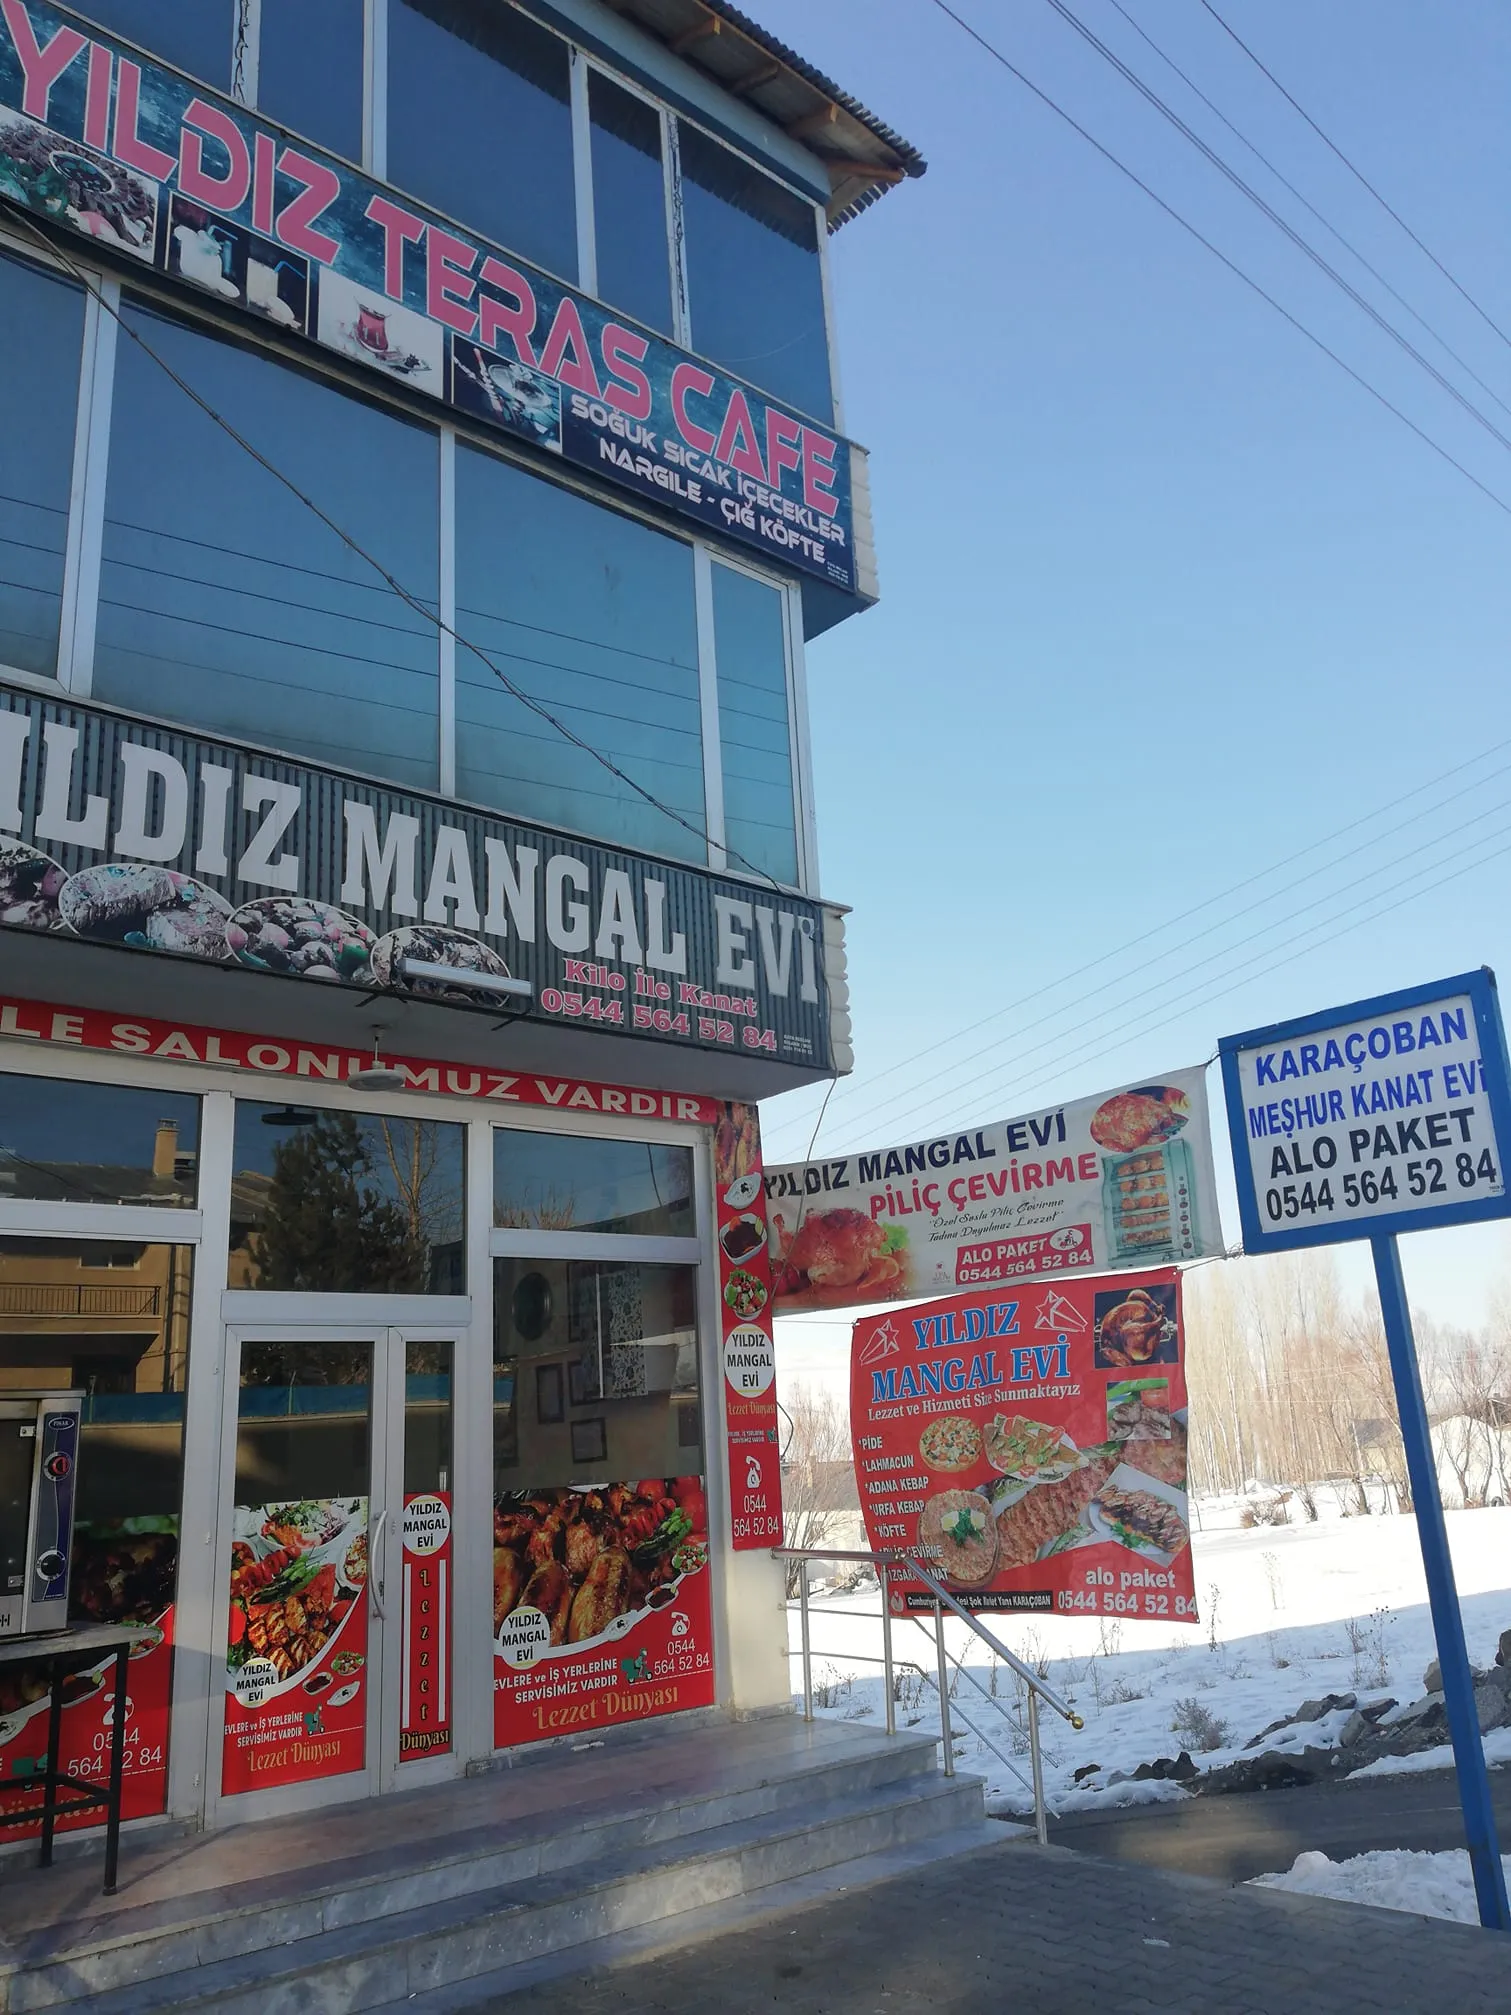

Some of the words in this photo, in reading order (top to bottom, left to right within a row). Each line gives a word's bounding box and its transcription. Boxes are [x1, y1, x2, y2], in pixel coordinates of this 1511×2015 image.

[2, 0, 341, 265] YILDIZ
[364, 194, 652, 420] TERAS
[671, 363, 839, 518] CAFE
[571, 394, 657, 454] SOĞUK
[663, 439, 732, 491] SICAK
[736, 468, 845, 547] İÇECEKLER
[760, 515, 826, 564] KÖFTE
[341, 799, 687, 975] MANGAL
[714, 895, 819, 1004] EVİ
[563, 957, 626, 991] Kilo
[634, 967, 671, 1000] İle
[677, 981, 758, 1017] Kanat
[541, 988, 624, 1024] 0544
[632, 1004, 691, 1035] 564
[698, 1016, 734, 1043] 52
[742, 1026, 778, 1051] 84
[1256, 1008, 1468, 1087] KARAÇOBAN
[1, 1006, 84, 1045] LE
[534, 1079, 701, 1121] VARDIR
[1248, 1089, 1346, 1139] MEŞHUR
[1351, 1069, 1433, 1118] KANAT
[764, 1160, 849, 1200] YILDIZ
[859, 1133, 996, 1184] MANGAL
[1007, 1108, 1067, 1153] EVİ
[1270, 1136, 1337, 1179] ALO
[1349, 1107, 1475, 1163] PAKET
[870, 1178, 942, 1220] PİLİÇ
[948, 1152, 1100, 1212] ÇEVİRME
[1266, 1178, 1334, 1221] 0544
[1343, 1166, 1398, 1208] 564
[1407, 1158, 1447, 1197] 52
[1456, 1148, 1497, 1188] 84
[962, 1248, 993, 1265] ALO
[997, 1237, 1048, 1260] PAKET
[959, 1267, 1002, 1282] 0544
[1007, 1258, 1036, 1275] 564
[1042, 1254, 1063, 1269] 52
[1068, 1249, 1092, 1265] 84
[912, 1302, 1021, 1350] YILDIZ
[731, 1333, 765, 1348] YILDIZ
[727, 1353, 772, 1368] MANGAL
[871, 1350, 1003, 1404] MANGAL
[1011, 1334, 1071, 1382] EVİ
[742, 1371, 760, 1388] EVİ
[868, 1407, 904, 1421] Lezzet
[906, 1406, 920, 1416] ve
[922, 1395, 970, 1414] Hizmeti
[994, 1382, 1081, 1403] Sunmaktayız
[899, 1476, 929, 1491] KEBAP
[409, 1502, 442, 1515] YILDIZ
[743, 1494, 767, 1513] 0544
[896, 1500, 926, 1514] KEBAP
[403, 1519, 448, 1532] MANGAL
[733, 1518, 750, 1537] 564
[753, 1517, 765, 1536] 52
[767, 1516, 779, 1535] 84
[417, 1534, 434, 1548] EVİ
[1086, 1566, 1114, 1586] alo
[1120, 1568, 1176, 1590] paket
[1058, 1590, 1097, 1610] 0544
[1103, 1591, 1138, 1613] 564
[1144, 1595, 1168, 1614] 52
[1174, 1596, 1198, 1616] 84
[508, 1613, 541, 1628] YILDIZ
[502, 1629, 547, 1646] MANGAL
[667, 1638, 695, 1655] 0544
[516, 1645, 534, 1662] EVİ
[654, 1659, 675, 1676] 564
[679, 1656, 692, 1671] 52
[696, 1652, 710, 1668] 84
[236, 1676, 276, 1691] MANGAL
[242, 1663, 272, 1676] YILDIZ
[494, 1674, 532, 1691] EVLERE
[534, 1675, 546, 1683] ve
[549, 1665, 560, 1681] İŞ
[562, 1656, 618, 1677] YERLERİNE
[248, 1689, 263, 1701] EVİ
[515, 1680, 578, 1704] SERVİSİMİZ
[580, 1675, 618, 1691] VARDIR
[532, 1699, 597, 1730] Lezzet
[601, 1686, 679, 1715] Dünyası
[93, 1728, 140, 1751] 054
[401, 1728, 449, 1752] Dünyası
[67, 1755, 103, 1778] 564
[140, 1745, 162, 1766] 84
[247, 1748, 289, 1772] Lezzet
[291, 1740, 341, 1765] Dünyası
